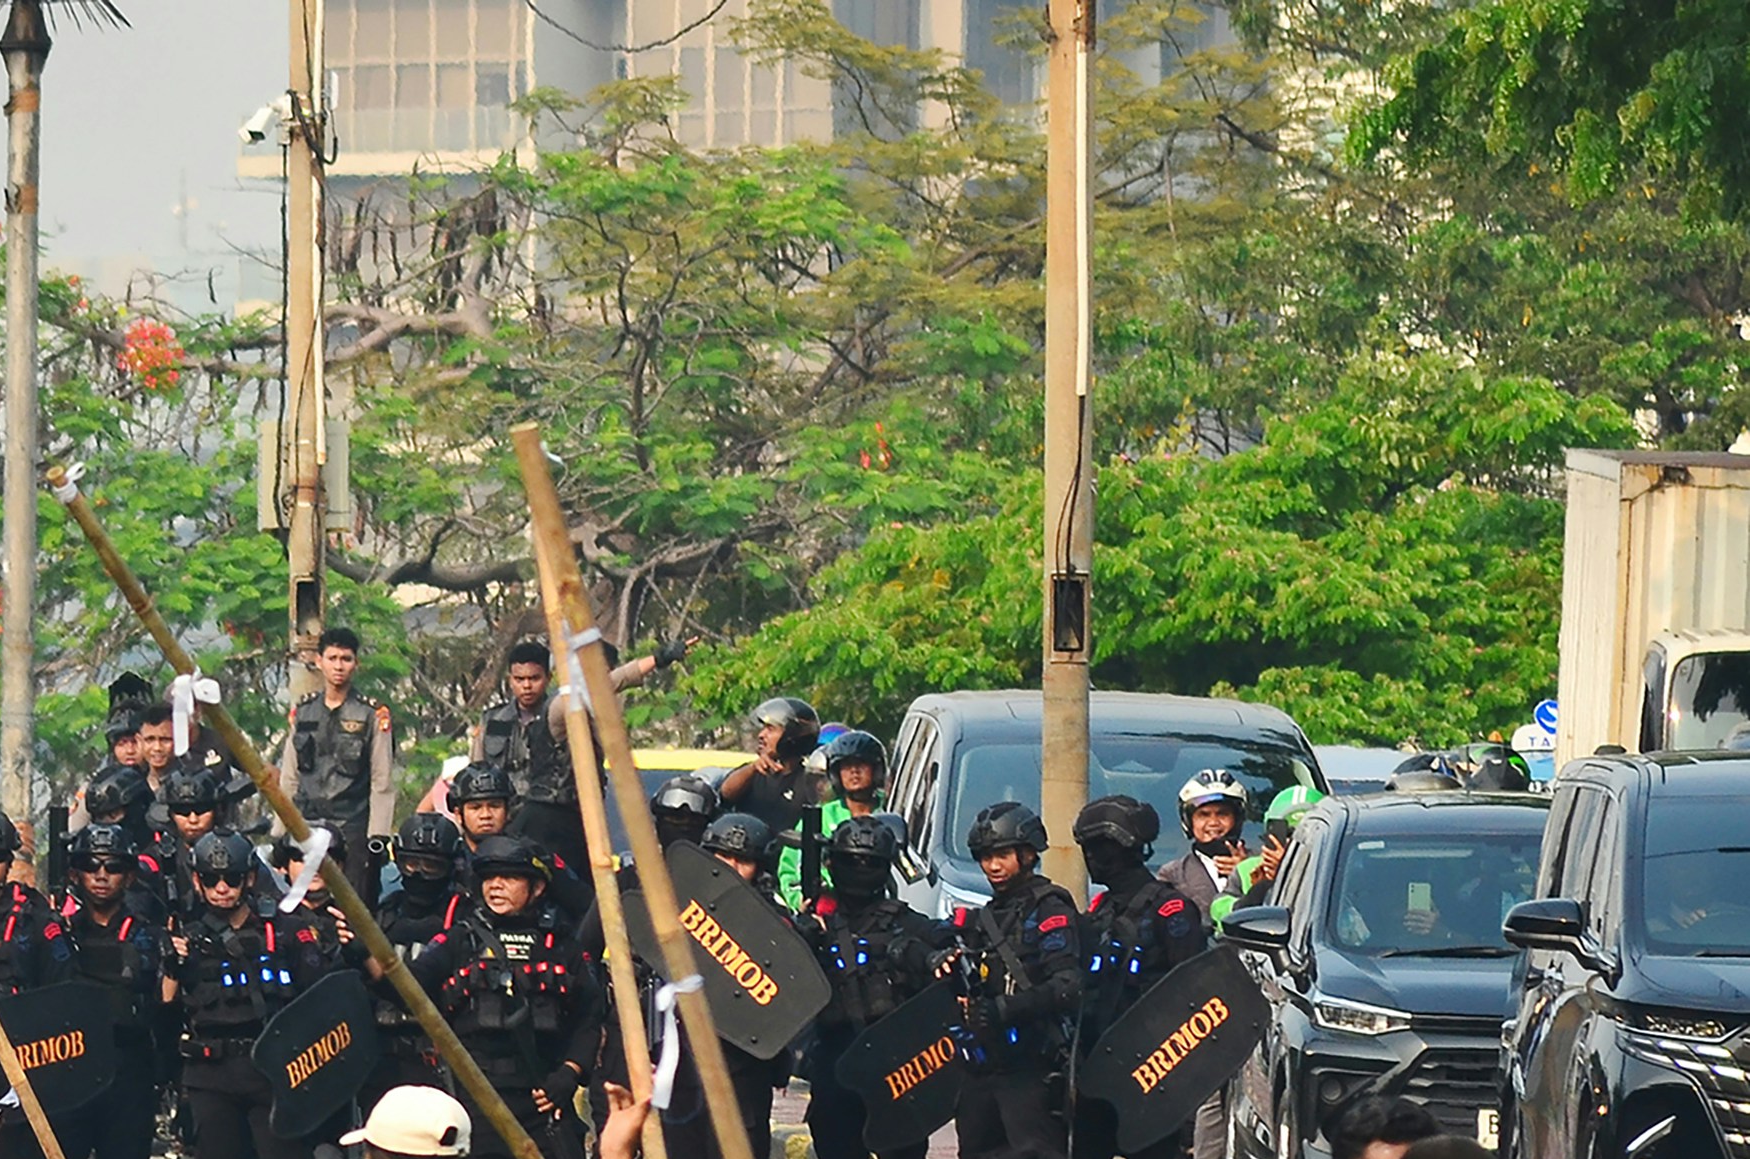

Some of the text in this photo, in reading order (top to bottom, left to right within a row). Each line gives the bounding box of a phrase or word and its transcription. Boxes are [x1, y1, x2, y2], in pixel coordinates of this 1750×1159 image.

[678, 899, 779, 1005] BRIMOB
[16, 1030, 85, 1071] RIMOB
[286, 1021, 351, 1089] BRIMOB
[884, 1036, 955, 1100] BRIMO
[1132, 996, 1229, 1094] BRIMOB
